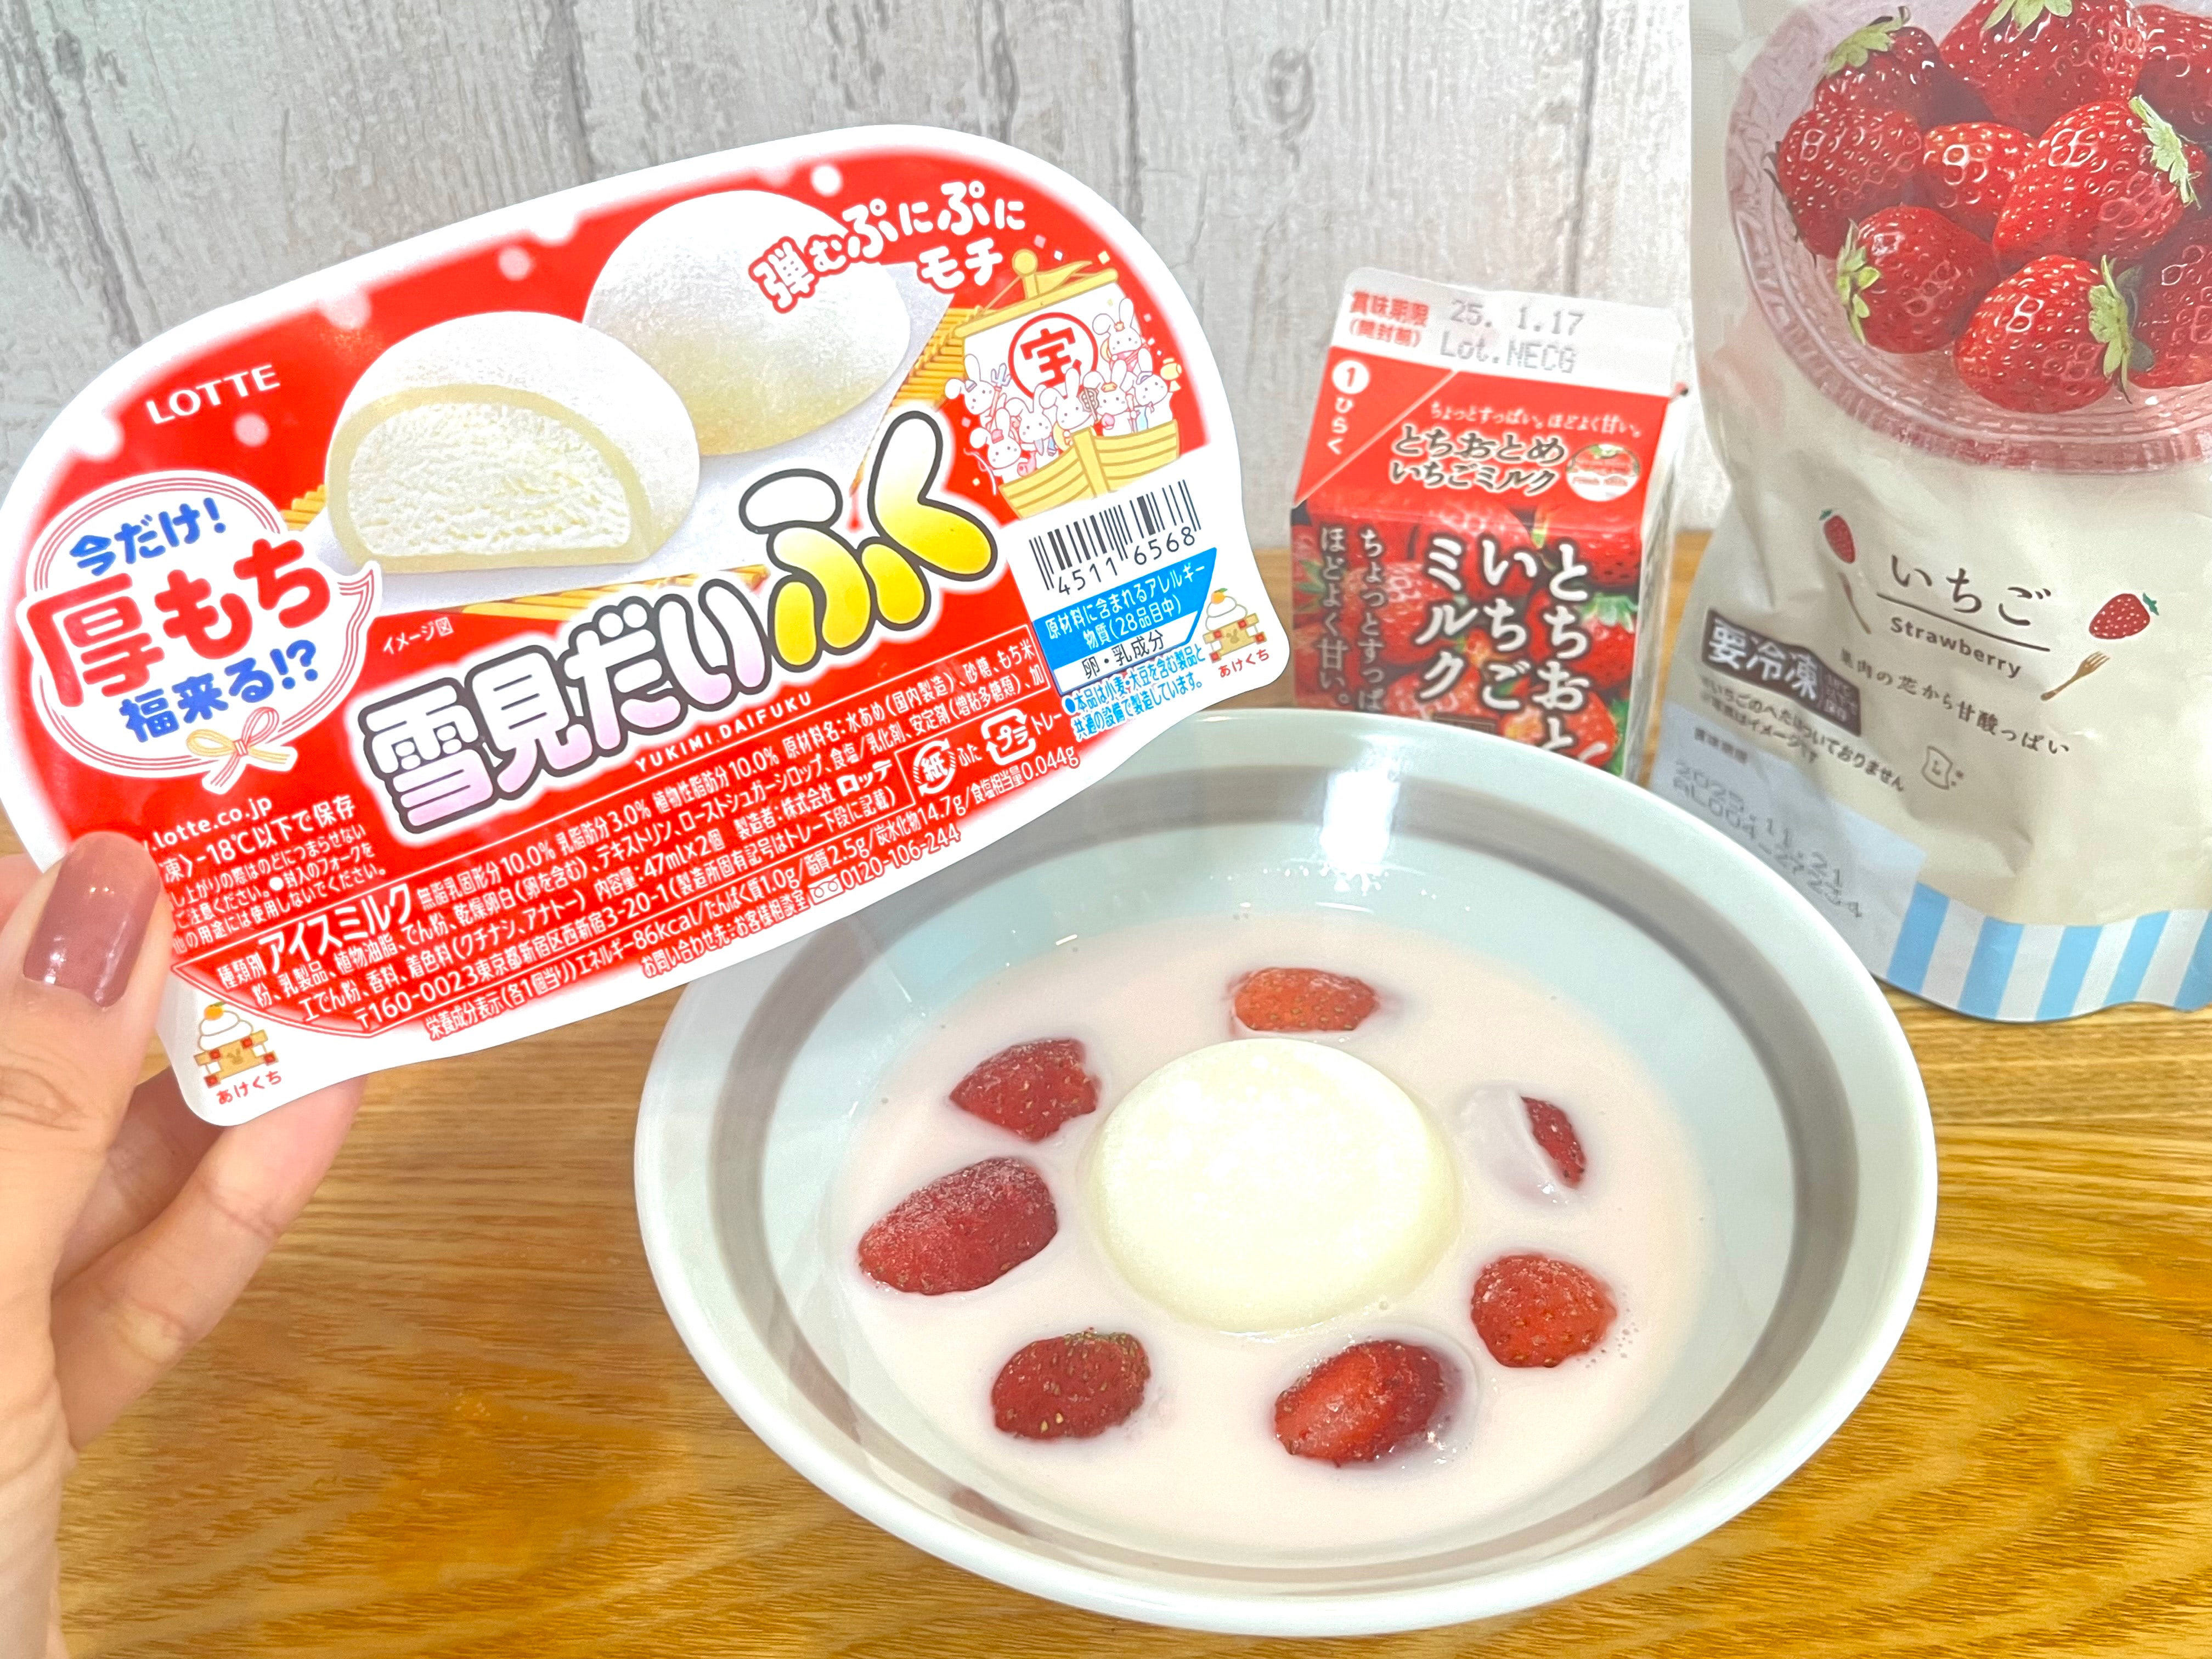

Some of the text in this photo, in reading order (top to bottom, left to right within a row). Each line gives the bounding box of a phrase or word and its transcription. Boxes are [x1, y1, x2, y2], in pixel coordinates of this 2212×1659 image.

[753, 181, 1025, 308] 弾むぷにぷに
[919, 238, 1005, 290] モチ
[1020, 329, 1083, 386] 宝
[146, 364, 280, 424] LOTTE
[1327, 399, 1353, 455] ひらく
[1393, 425, 1567, 465] とちおとめ
[1390, 460, 1558, 495] いちごミルク
[1058, 527, 1195, 595] 4511 6568
[1891, 553, 2052, 627] いちご
[27, 538, 331, 707] 厚もち
[358, 410, 998, 836] 雪見だいふく
[1045, 565, 1205, 640] 原材料に含まれるアレルギー
[1319, 526, 1351, 705] ほどよく甘い。
[1415, 537, 1479, 699] ミルク
[1482, 539, 1537, 710] いちご
[382, 617, 453, 654] イメージ図
[1082, 630, 1165, 679] 卵・乳成分
[1218, 648, 1270, 679] あけくち
[1708, 617, 1817, 701] 要冷凍
[1890, 616, 2022, 679] Strawberry
[635, 691, 812, 773] YUKIMI DAIFUKU
[919, 712, 1062, 782] 紙 ふた プラ トレー
[837, 759, 893, 797] ロッテ
[144, 796, 273, 853] .lotte.co.jp
[841, 826, 961, 890] 0120-106-244
[217, 952, 265, 990] 種類別
[258, 883, 413, 974] アイスミルク
[216, 1070, 282, 1105] あけくち
